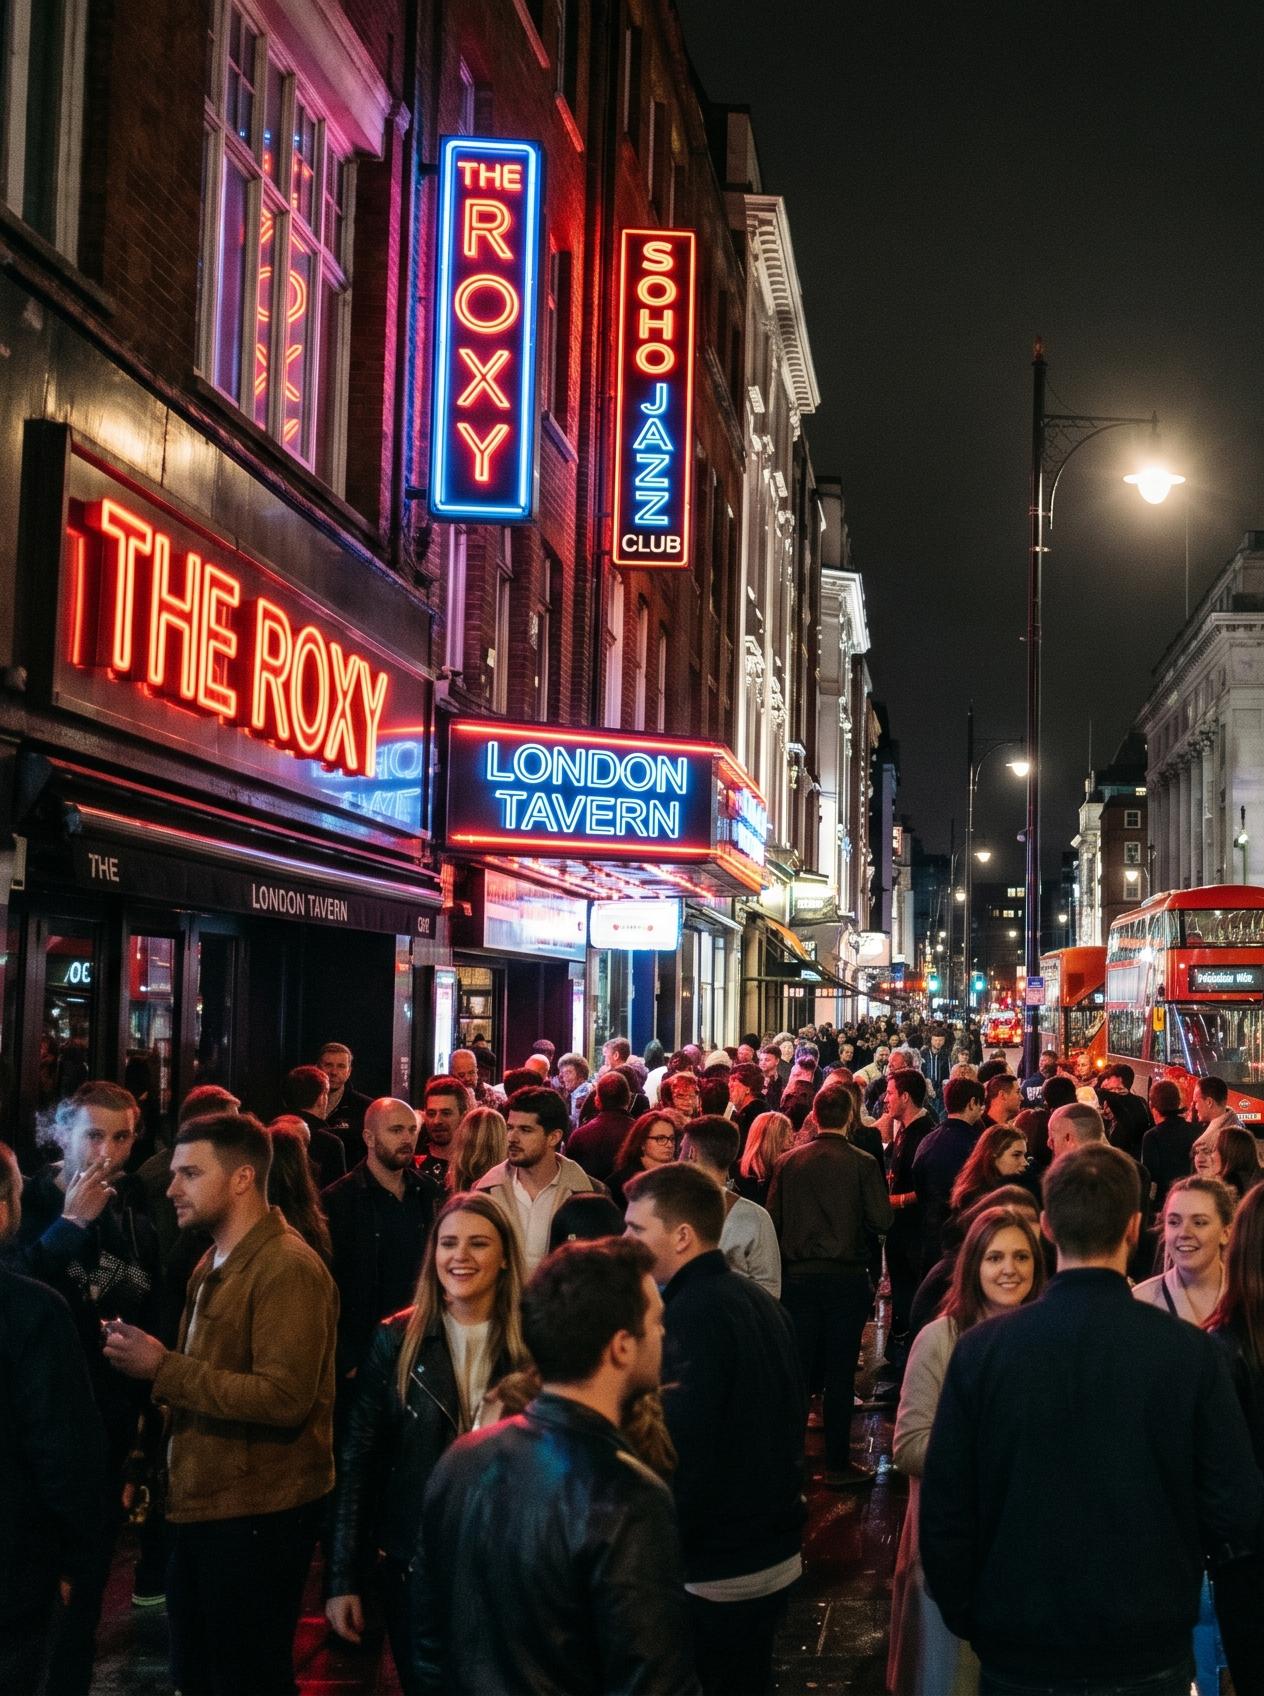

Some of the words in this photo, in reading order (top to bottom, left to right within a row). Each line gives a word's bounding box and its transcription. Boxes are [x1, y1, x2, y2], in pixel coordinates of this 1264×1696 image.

[456, 160, 523, 190] THE
[636, 241, 677, 375] SOHO
[454, 198, 519, 482] ROXY
[632, 382, 674, 525] JAZZ
[621, 534, 681, 553] CLUB
[101, 498, 240, 718] THE
[251, 597, 388, 777] ROXY
[486, 741, 688, 795] LONDON
[494, 790, 680, 838] TAVERN
[88, 852, 120, 882] THE
[252, 883, 305, 916] LONDON
[308, 894, 348, 922] TAVERN
